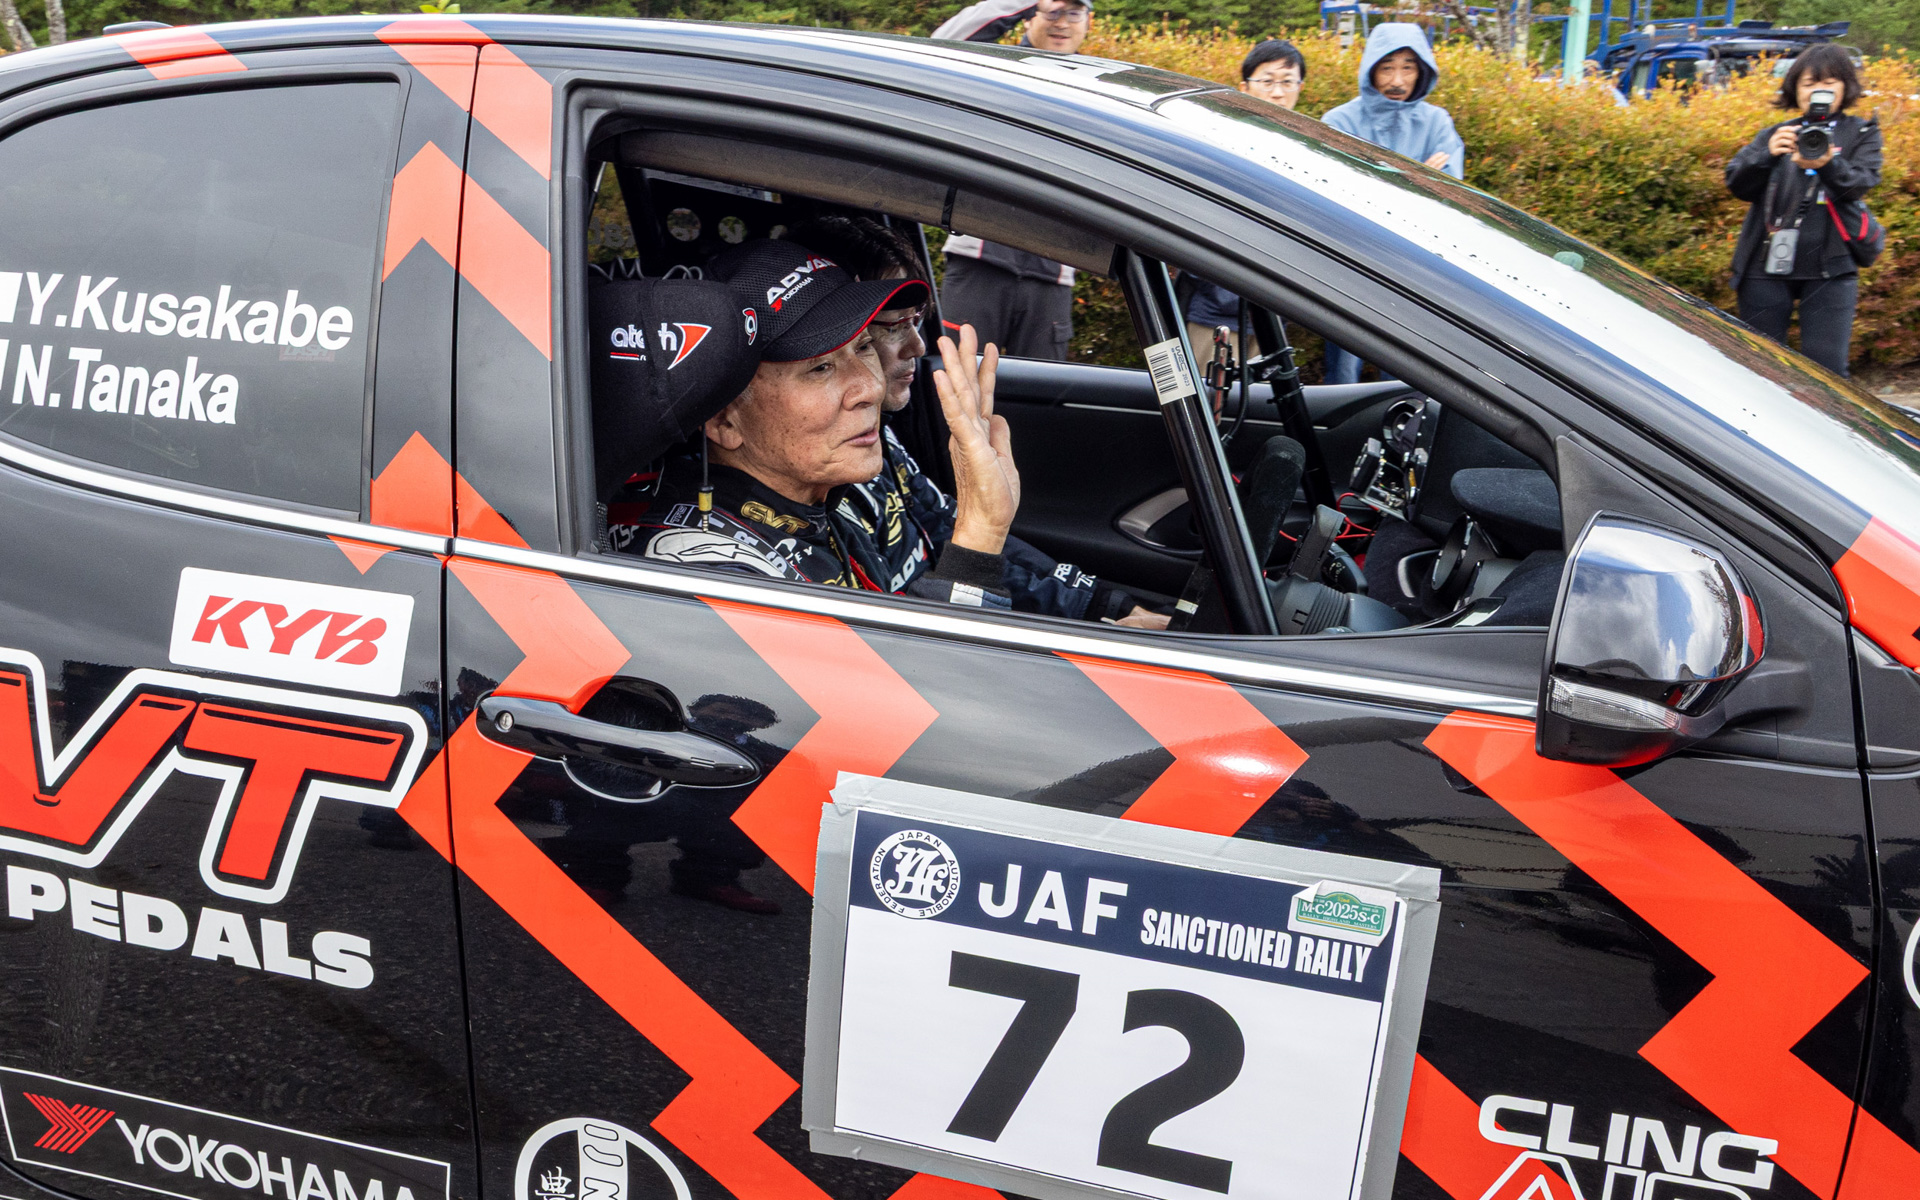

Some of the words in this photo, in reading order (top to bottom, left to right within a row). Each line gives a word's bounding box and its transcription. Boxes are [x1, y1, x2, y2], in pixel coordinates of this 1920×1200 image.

[26, 271, 354, 351] Y.Kusakabe
[12, 343, 239, 425] N.Tanaka
[191, 595, 388, 666] KYB
[898, 831, 942, 848] JAPAN
[872, 847, 906, 914] FEDERATION
[918, 859, 959, 917] AUTOMOBILE
[978, 864, 1128, 936] JAF
[7, 865, 375, 989] PEDALS
[1140, 908, 1291, 970] SANCTIONED
[1295, 935, 1372, 983] RALLY
[945, 950, 1246, 1195] 72
[1478, 1094, 1779, 1190] CLING
